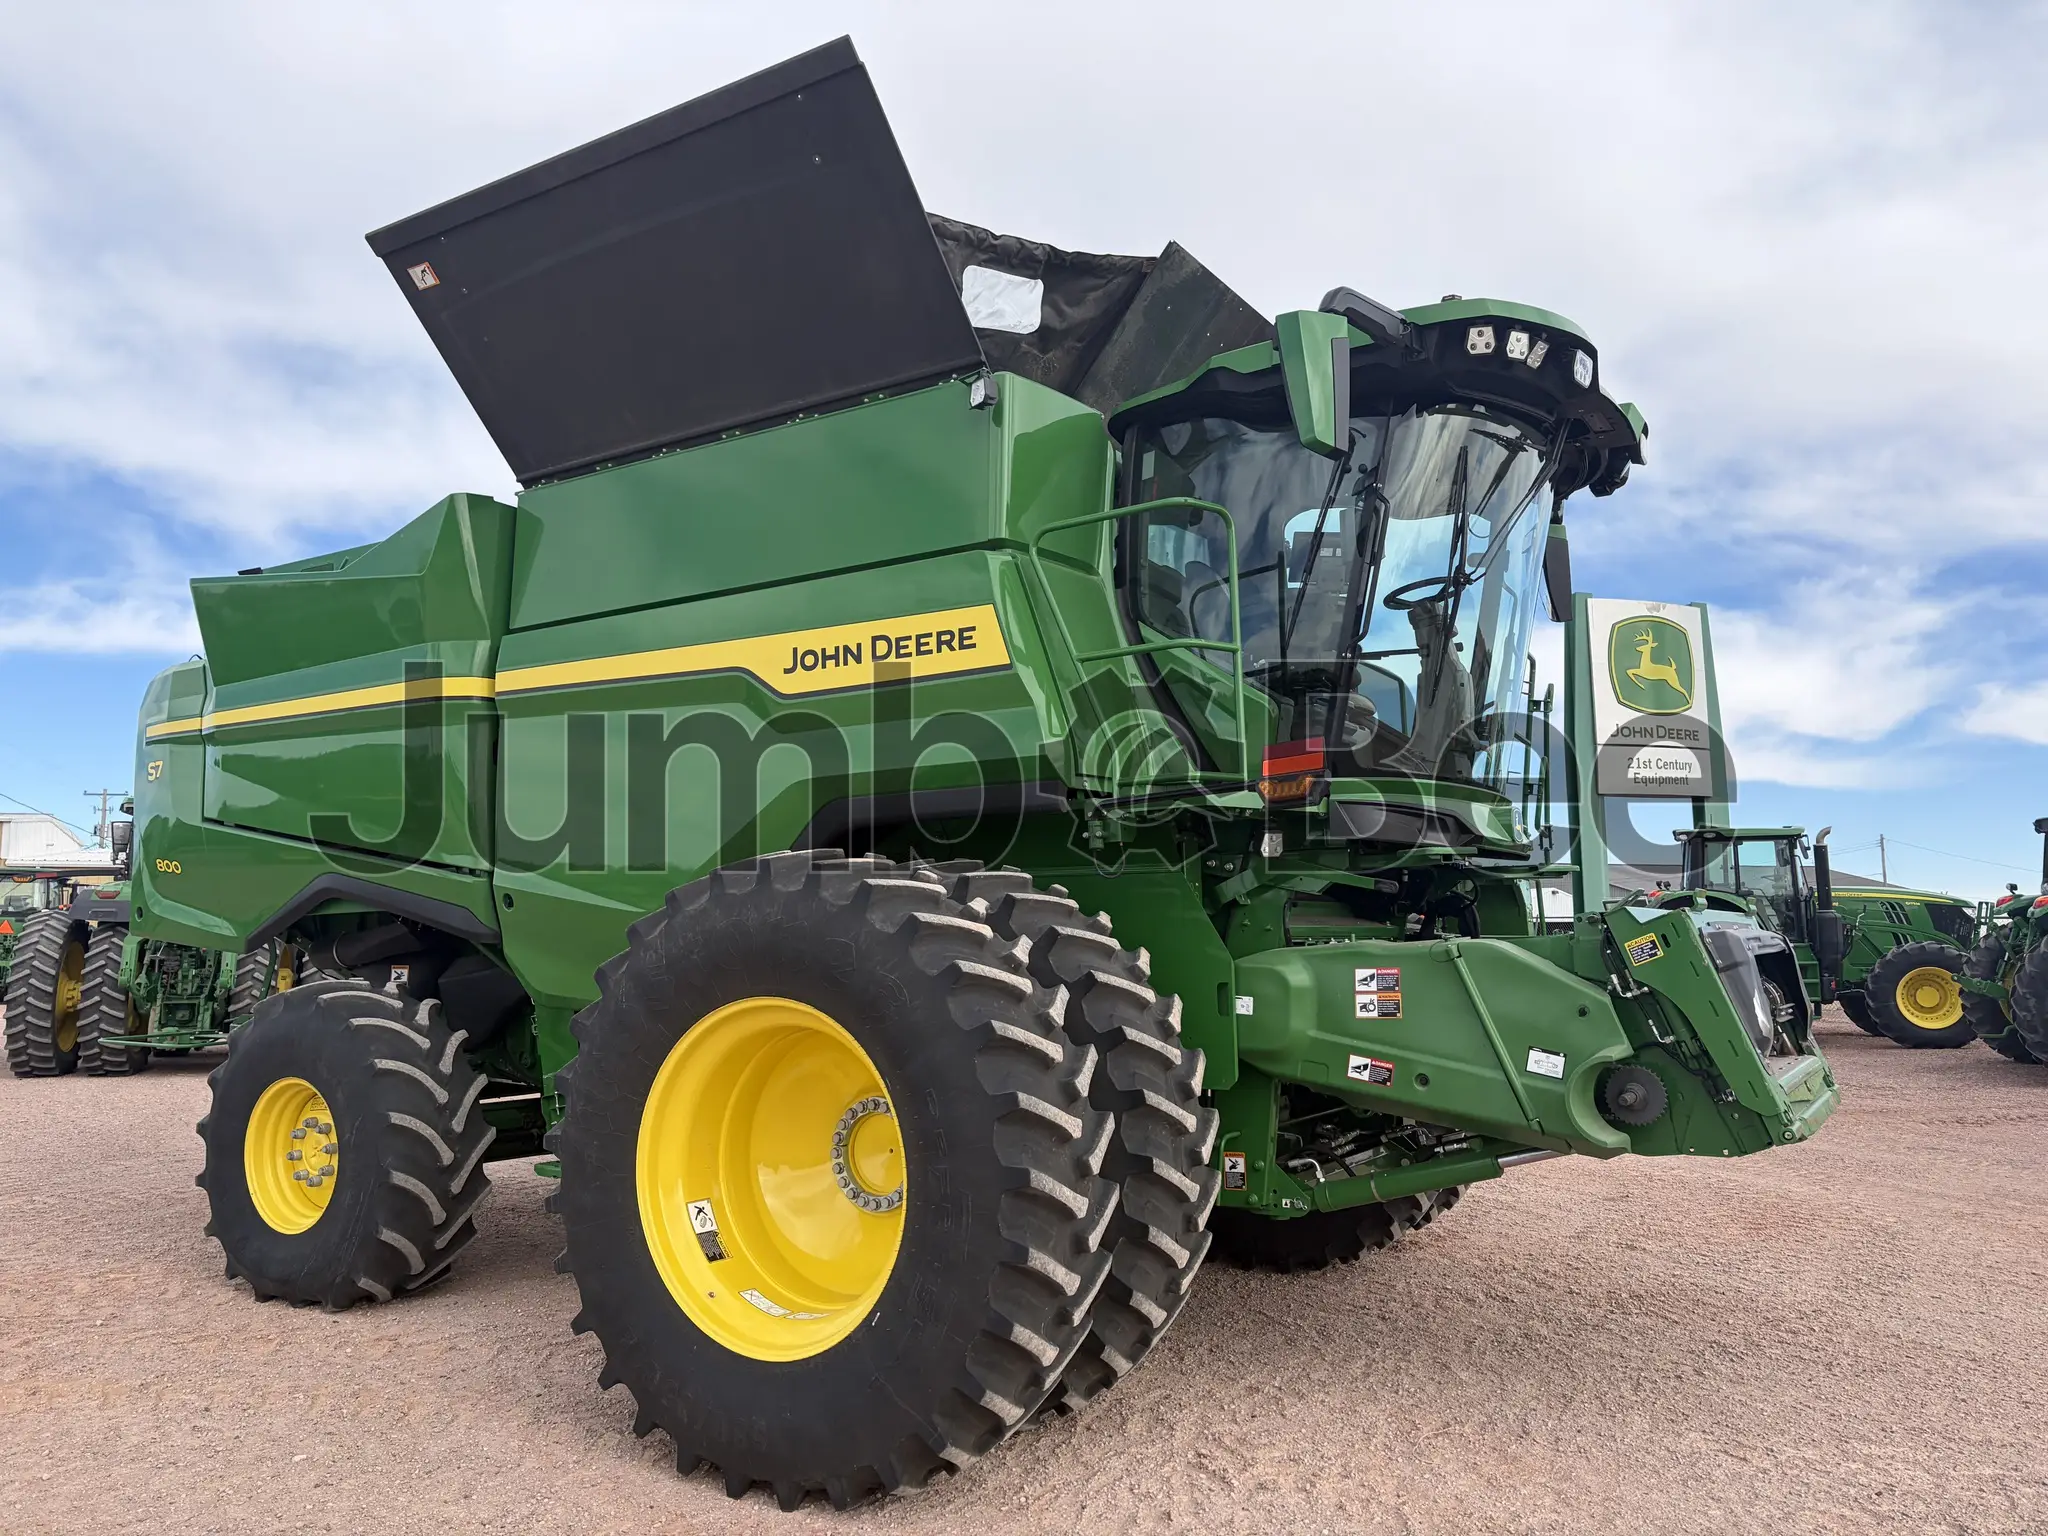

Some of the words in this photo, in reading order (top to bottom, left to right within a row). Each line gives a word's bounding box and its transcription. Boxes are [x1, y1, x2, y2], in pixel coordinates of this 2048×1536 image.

[783, 642, 863, 675] JOHN
[871, 625, 977, 663] DEERE
[1610, 723, 1654, 739] JOHN
[1656, 724, 1700, 742] DEERE
[147, 760, 164, 782] S7
[1627, 757, 1653, 770] 21st
[1655, 757, 1693, 774] Century
[1633, 772, 1689, 787] Equipment
[156, 858, 182, 874] 800
[1630, 934, 1655, 947] CAUTION
